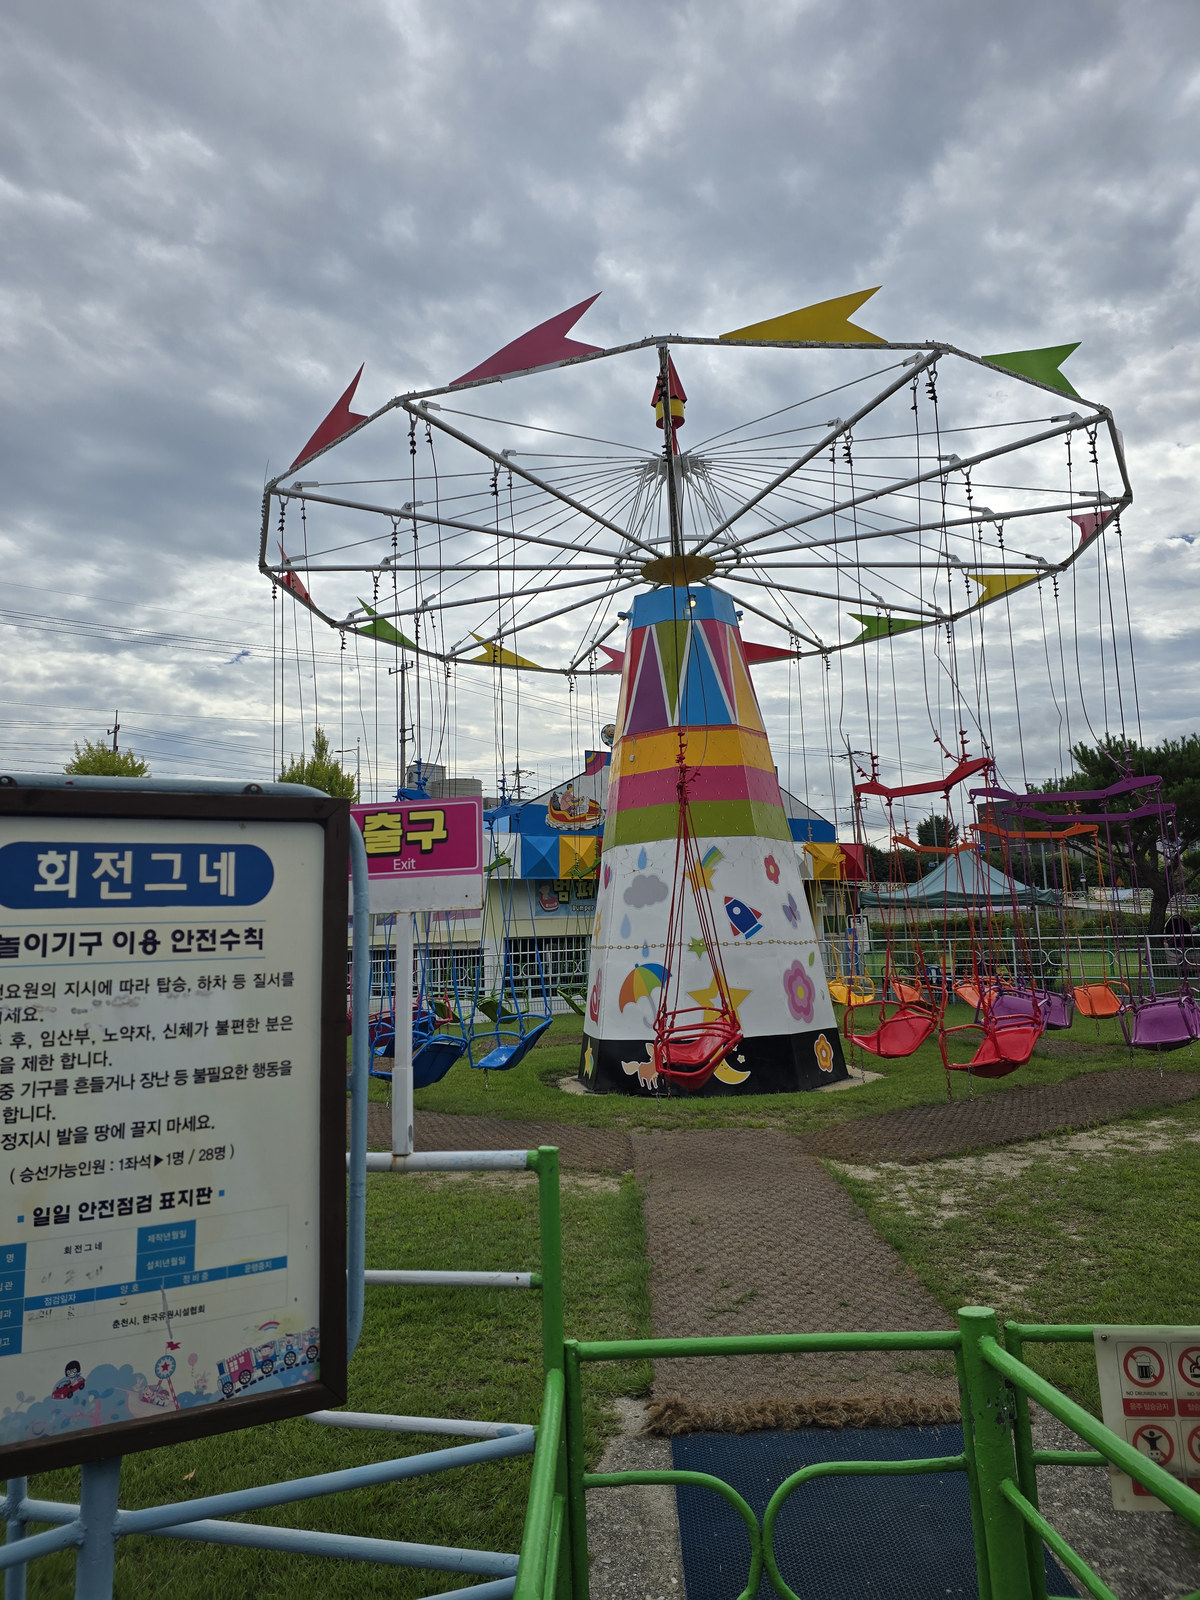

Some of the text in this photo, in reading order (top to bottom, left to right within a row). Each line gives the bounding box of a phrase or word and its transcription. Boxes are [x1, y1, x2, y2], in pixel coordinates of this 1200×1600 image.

[362, 809, 449, 858] 출구
[34, 850, 236, 900] 회전그네
[393, 858, 416, 870] Exit
[113, 929, 161, 955] 이용
[171, 927, 264, 953] 안전수칙
[0, 971, 294, 1000] 요원의 지시에 따라 탑승, 하차 등 질서를
[10, 1032, 32, 1049] 후,
[41, 1028, 95, 1047] 임산부,
[102, 1024, 155, 1042] 노약자,
[163, 1020, 209, 1039] 신체가
[215, 1017, 260, 1036] 불편한
[265, 1015, 293, 1032] 분은
[21, 1054, 54, 1072] 제한
[60, 1050, 112, 1070] 합니다.
[0, 1060, 292, 1101] 중 기구를 흔들거나 장난 등 불필요한 행동을
[2, 1104, 56, 1124] 합니다.
[1, 1114, 215, 1151] 정지시 발을 땅에 끌지 마세요.
[33, 1187, 213, 1227] 일일 안전점검 표지판
